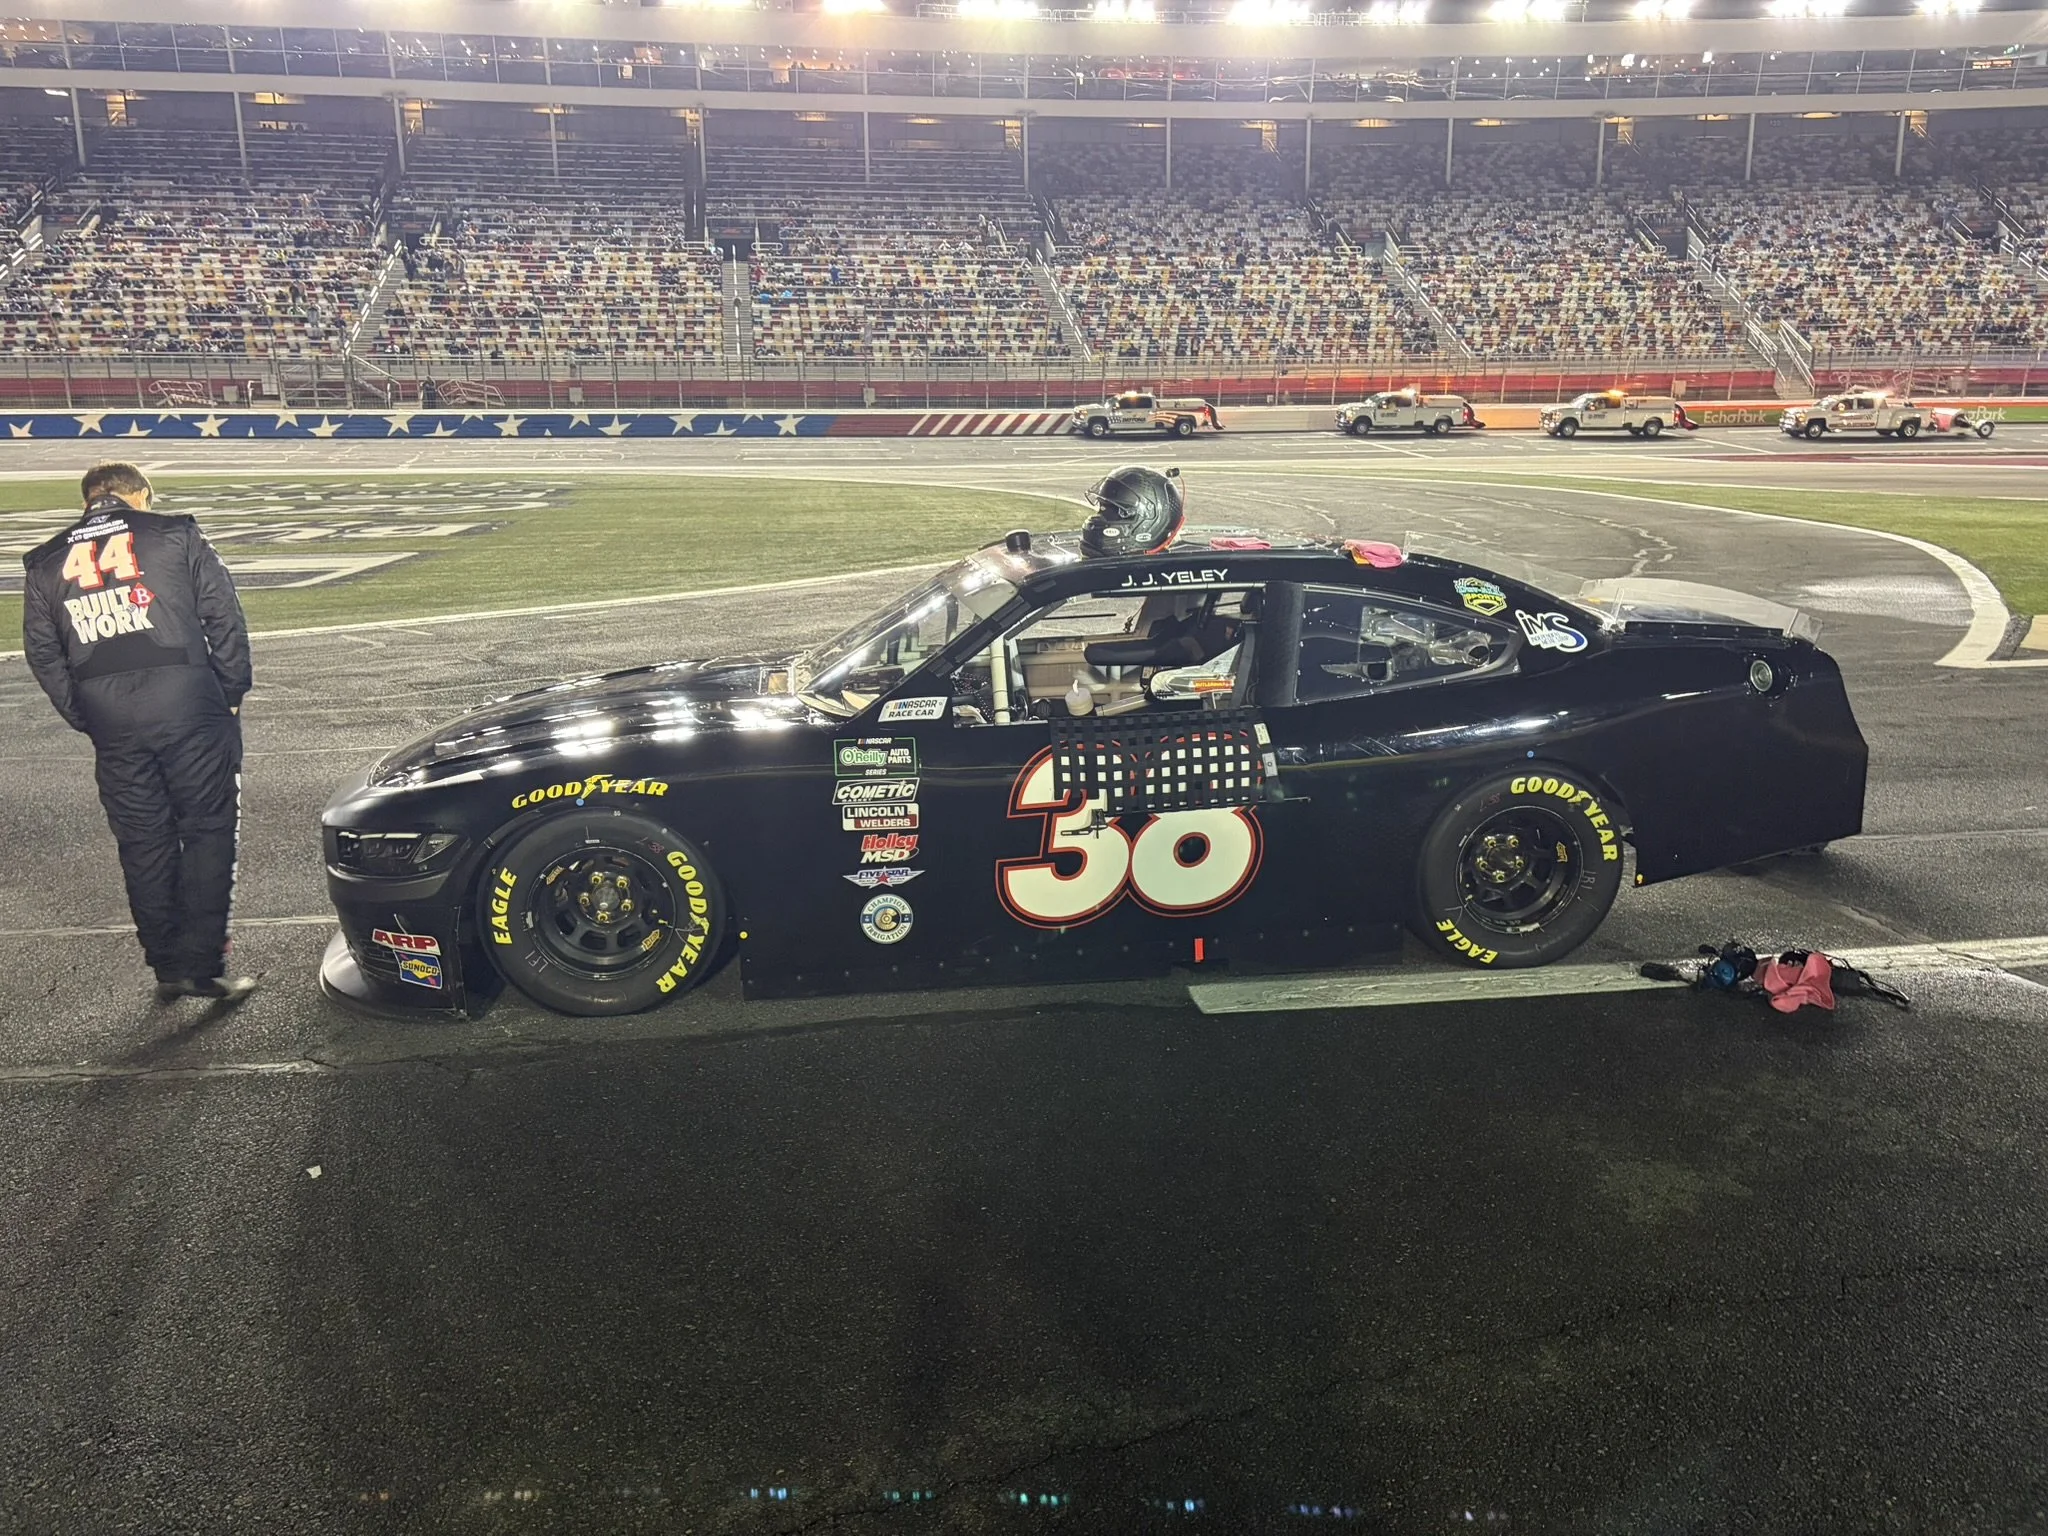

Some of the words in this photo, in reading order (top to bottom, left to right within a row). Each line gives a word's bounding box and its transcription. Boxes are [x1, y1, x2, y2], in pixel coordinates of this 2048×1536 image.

[1704, 408, 1766, 424] EchoPark
[62, 532, 141, 590] 44
[1121, 575, 1137, 587] J.
[1142, 573, 1158, 585] J.
[1161, 568, 1228, 584] YELEY
[64, 585, 131, 621] BUILT
[135, 587, 151, 604] B
[72, 605, 154, 644] WORK
[900, 699, 938, 710] NASCAR
[888, 709, 912, 718] RACE
[864, 737, 892, 745] NASCAR
[842, 748, 886, 765] O'Reilly
[890, 748, 909, 756] AUTO
[887, 756, 911, 764] PARTS
[864, 768, 887, 776] SERIES
[837, 781, 915, 799] COMETIC
[846, 807, 905, 818] LINCOLN
[860, 819, 910, 828] WELDERS
[862, 832, 918, 851] Holley
[860, 849, 910, 863] MSD
[860, 870, 882, 879] FIVE
[885, 869, 909, 877] STAR
[491, 867, 518, 945] EAGLE
[867, 897, 907, 912] CHAMPION
[374, 930, 436, 950] ARP
[866, 924, 907, 941] IRRIGATION
[1436, 918, 1498, 964] EAGLE
[402, 961, 438, 974] SUNOCO
